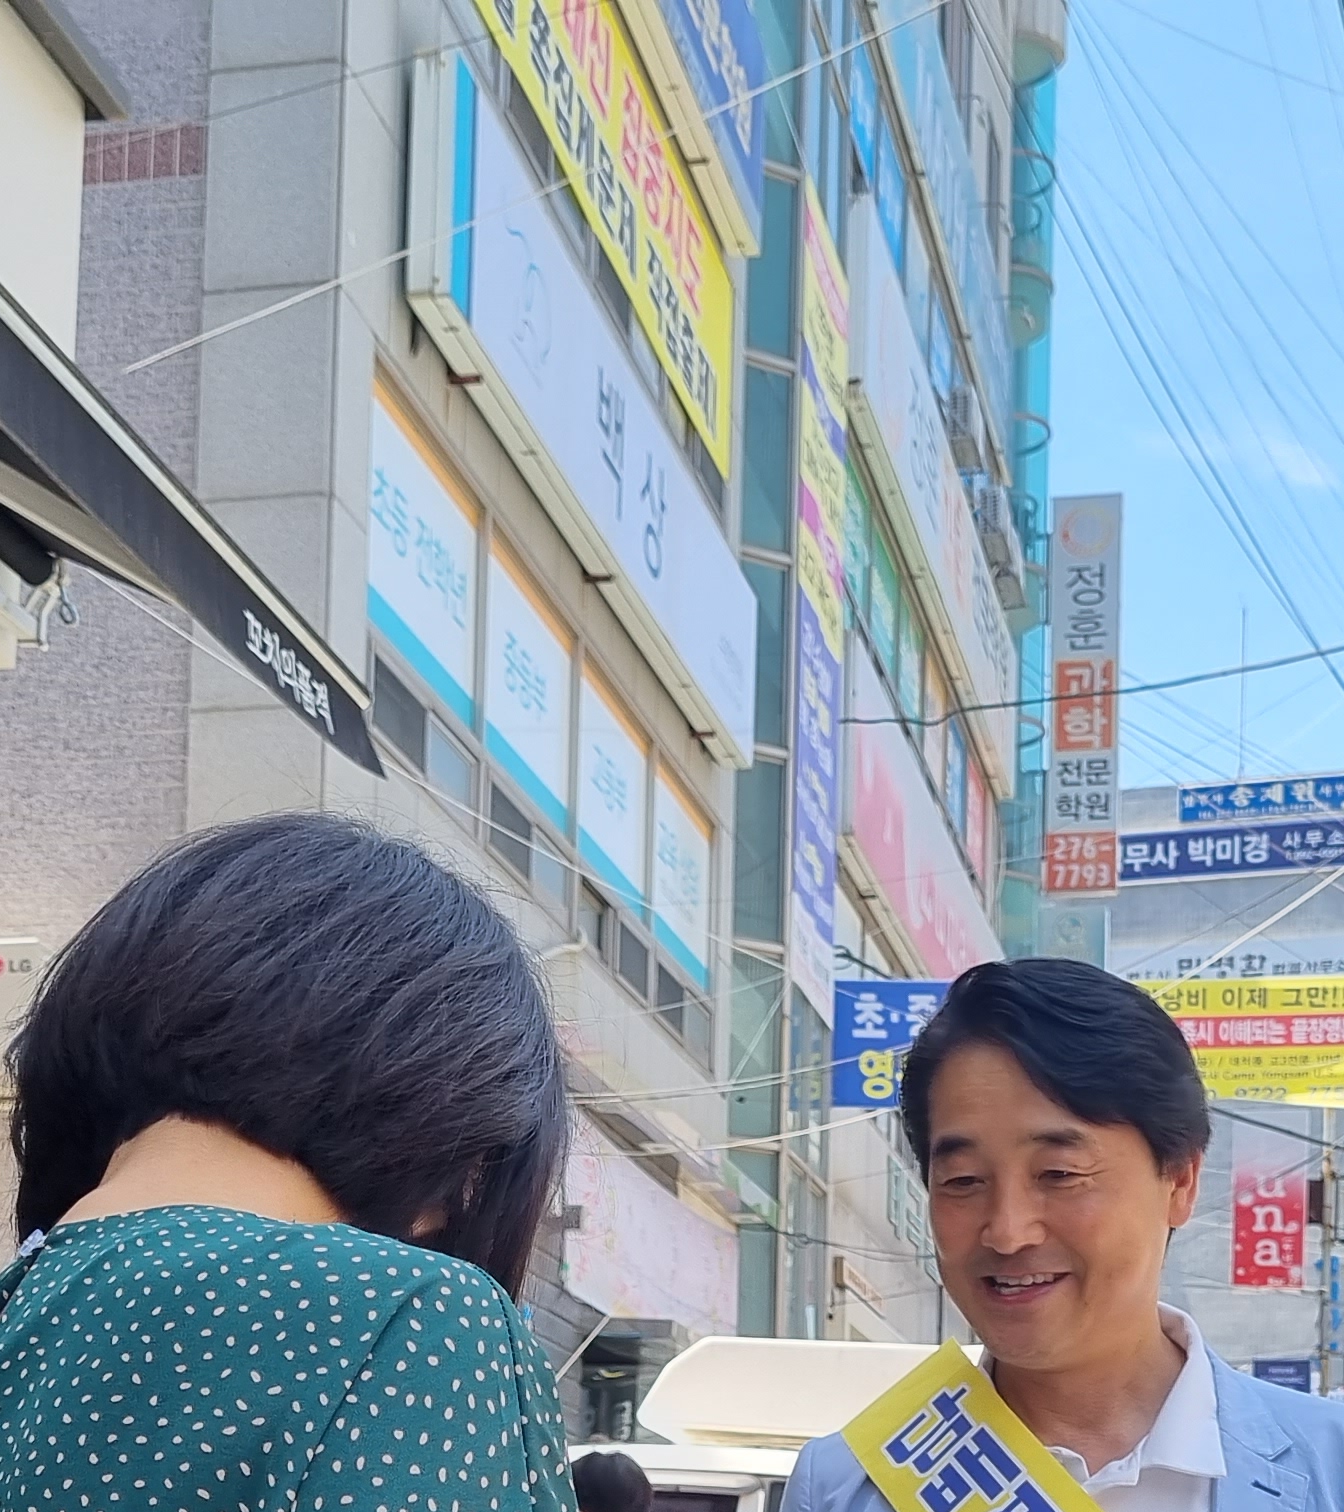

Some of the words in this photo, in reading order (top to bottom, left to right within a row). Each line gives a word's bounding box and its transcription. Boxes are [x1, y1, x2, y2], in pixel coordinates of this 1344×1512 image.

[1063, 562, 1108, 653] 정훈
[1062, 662, 1114, 750] 과학
[1056, 757, 1112, 788] 전문
[1056, 791, 1112, 824] 학원
[1054, 835, 1116, 862] 276-
[1118, 841, 1181, 872] 무사
[1187, 831, 1271, 868] 박미경
[1052, 863, 1112, 889] 7793
[8, 959, 32, 974] LG
[1221, 988, 1269, 1011] 이제
[1218, 1018, 1287, 1046] 이해되는
[859, 1049, 905, 1099] 영
